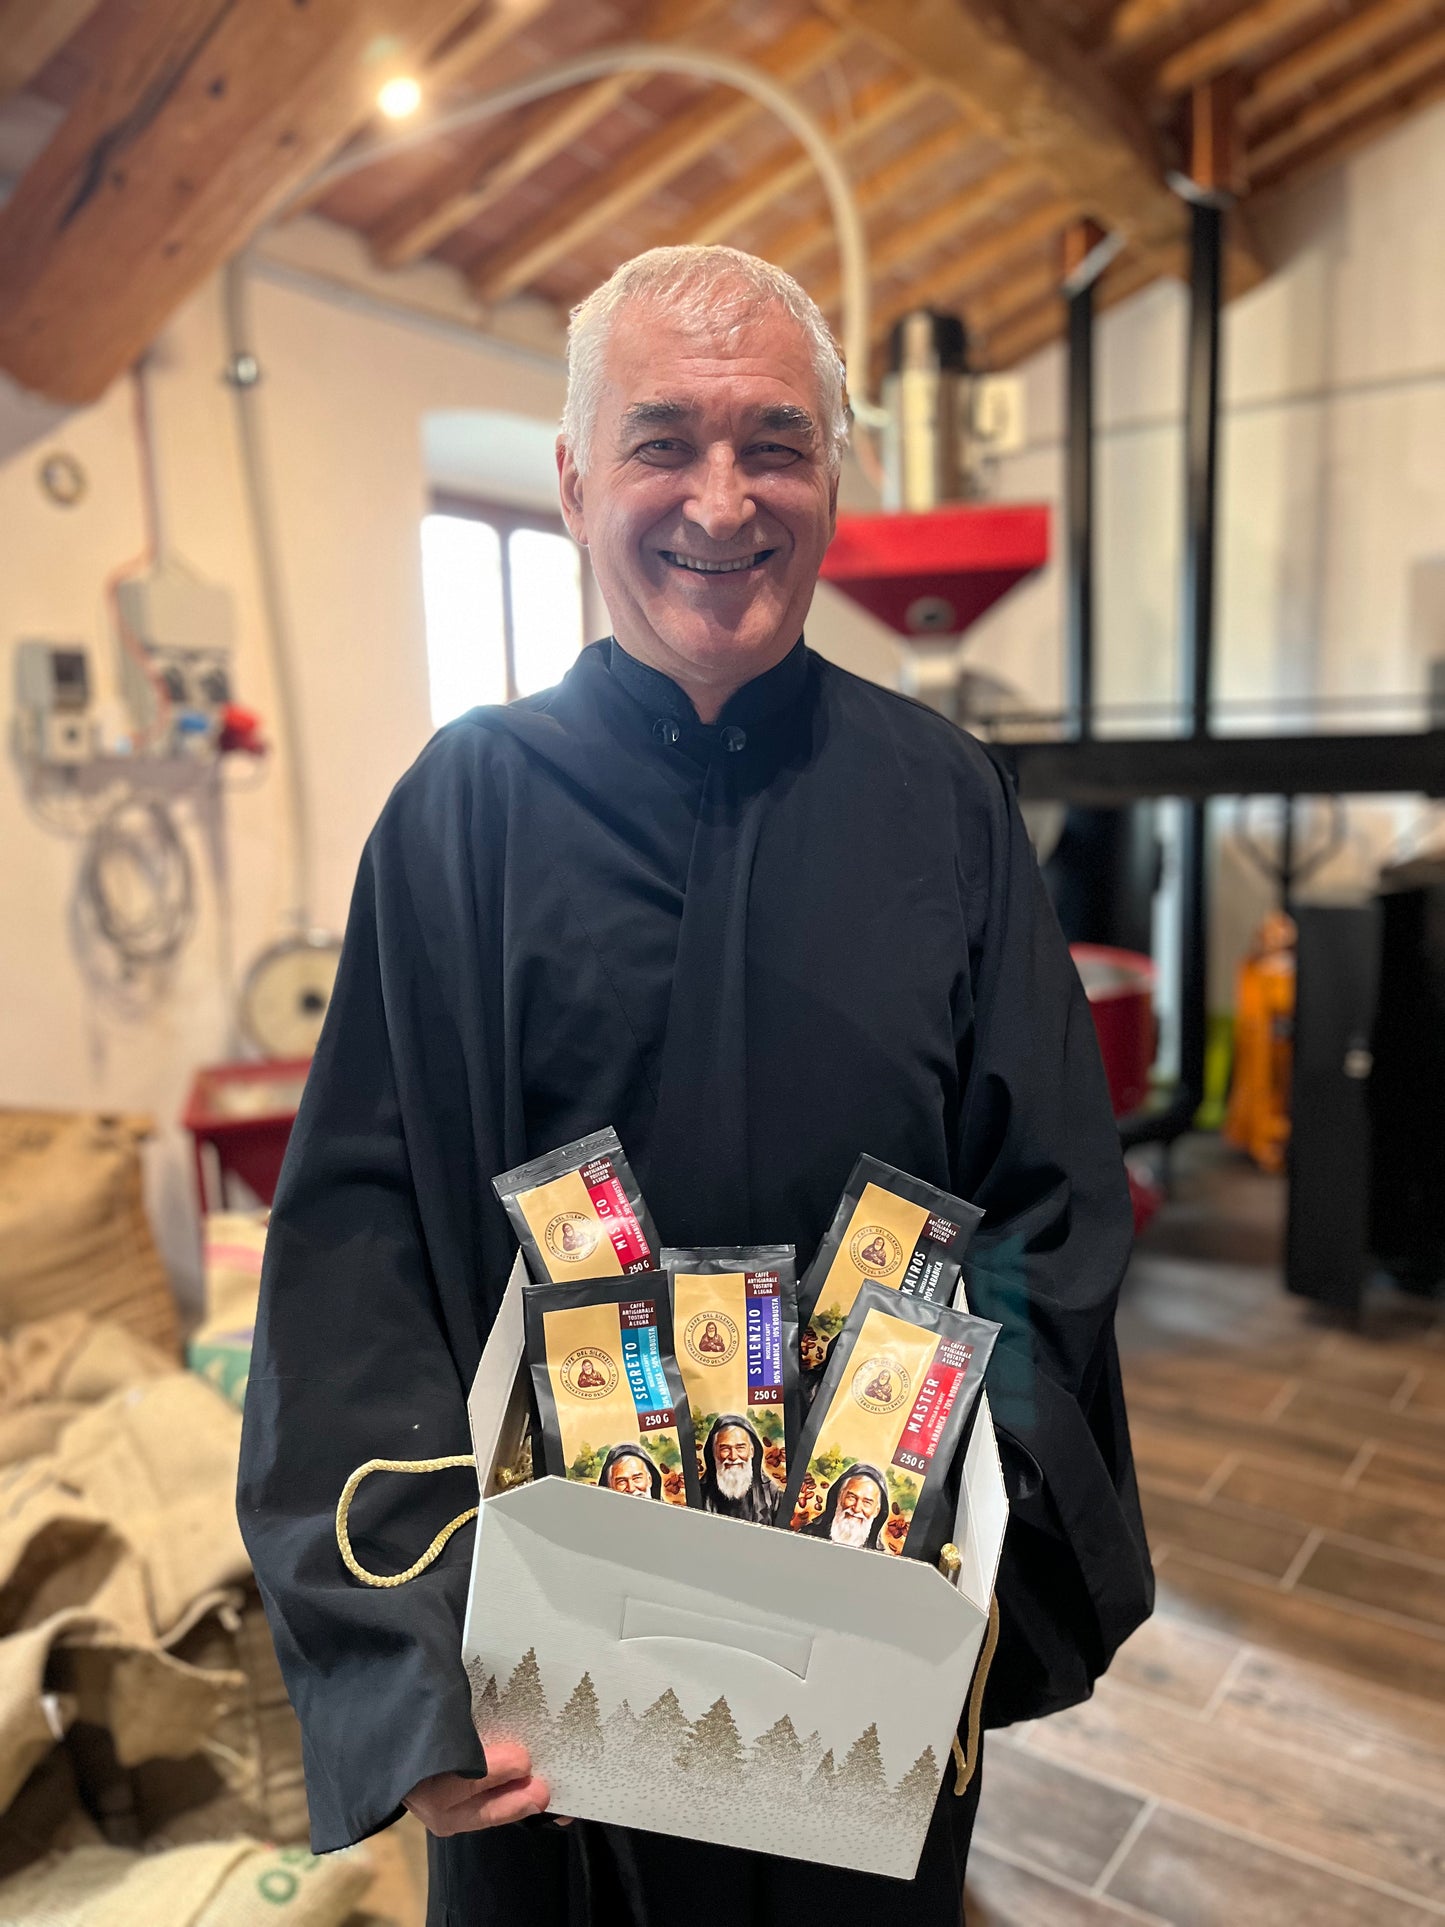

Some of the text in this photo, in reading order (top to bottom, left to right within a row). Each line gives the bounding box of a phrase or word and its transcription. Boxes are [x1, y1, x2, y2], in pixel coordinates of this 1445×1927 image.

[612, 1180, 626, 1204] ROBUSTA
[597, 1200, 626, 1249] MISICO
[629, 1260, 649, 1274] 250 G
[901, 1252, 925, 1295] KAIROS
[924, 1262, 943, 1301] 00% ARABICA
[623, 1307, 653, 1315] ARTIGIANALE
[648, 1327, 656, 1355] ROBUSTA
[749, 1310, 761, 1374] SILENZIO
[625, 1343, 648, 1399] SEGRETO
[755, 1390, 777, 1400] 250 G
[908, 1379, 938, 1432] MASTER
[646, 1413, 669, 1425] 250 G
[926, 1443, 936, 1456] 30%
[932, 1416, 946, 1442] ARABICA
[943, 1399, 953, 1410] 70%
[949, 1373, 964, 1397] ROBUSTA
[900, 1453, 924, 1469] 250 G
